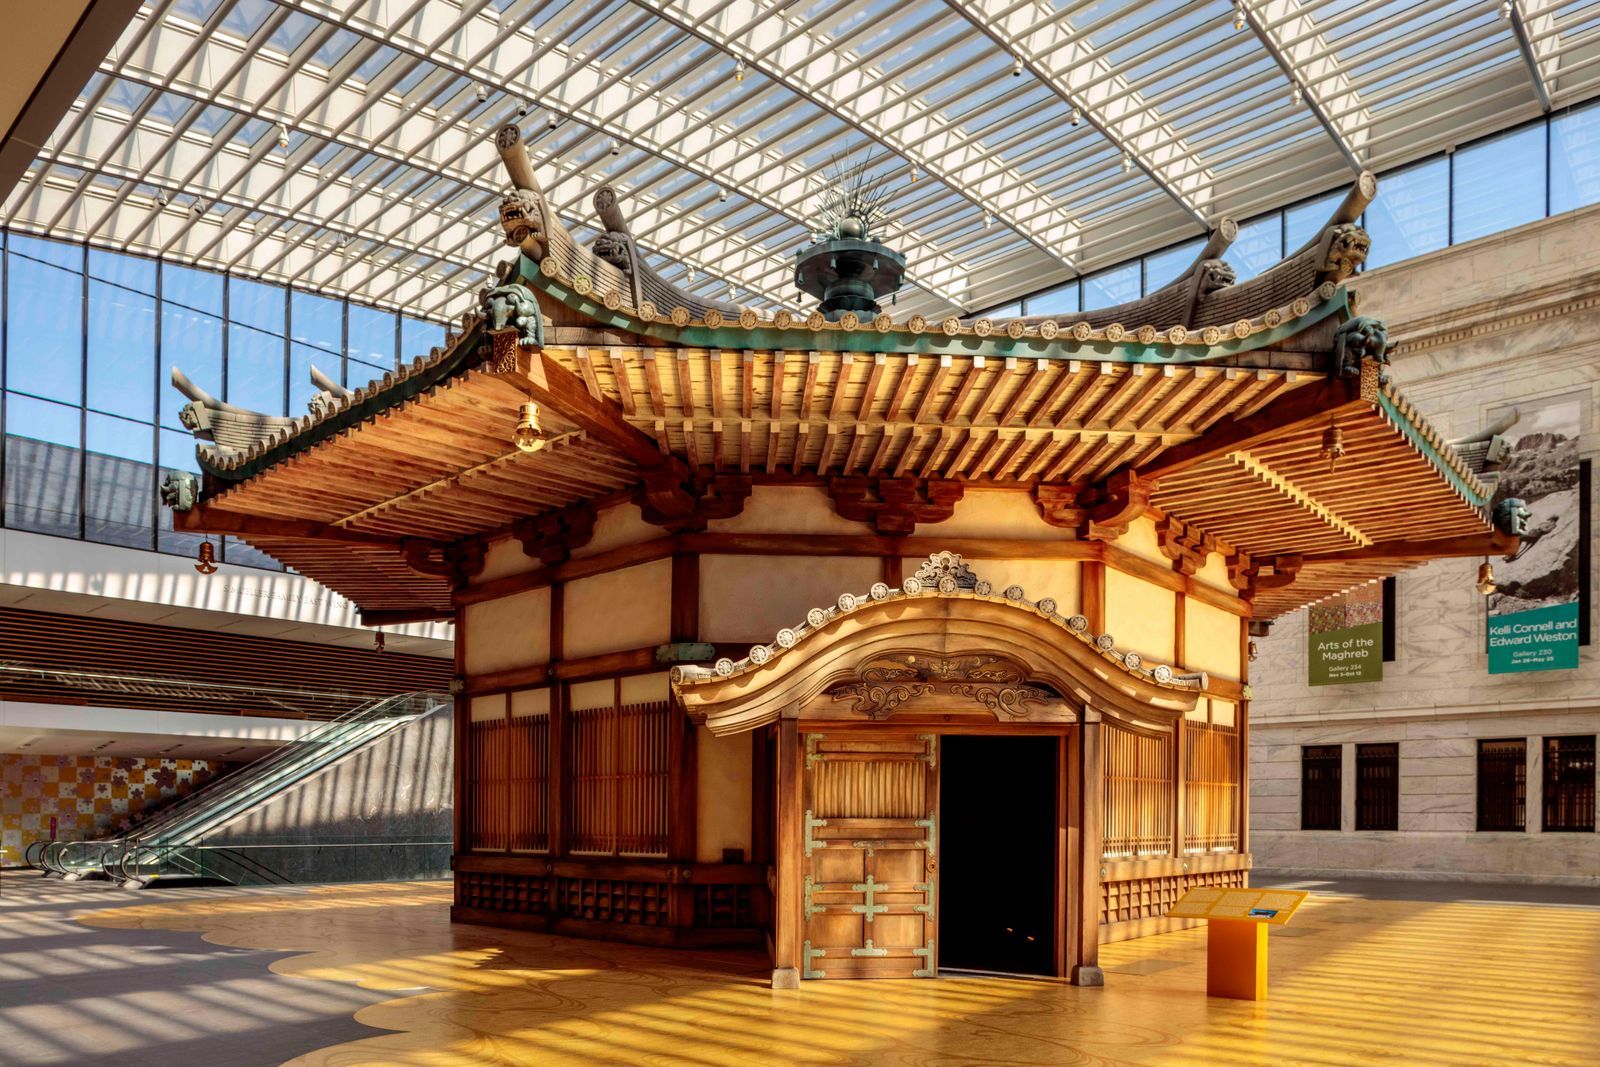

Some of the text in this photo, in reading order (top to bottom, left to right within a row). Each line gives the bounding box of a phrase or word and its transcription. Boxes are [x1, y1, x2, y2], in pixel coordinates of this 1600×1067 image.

[1489, 618, 1577, 635] Kelli Connell and
[1317, 638, 1374, 651] Arts of the
[1489, 632, 1577, 647] Edward Weston
[1322, 648, 1369, 661] Maghreb
[1513, 650, 1537, 658] Gallery
[1328, 665, 1349, 673] Gallery
